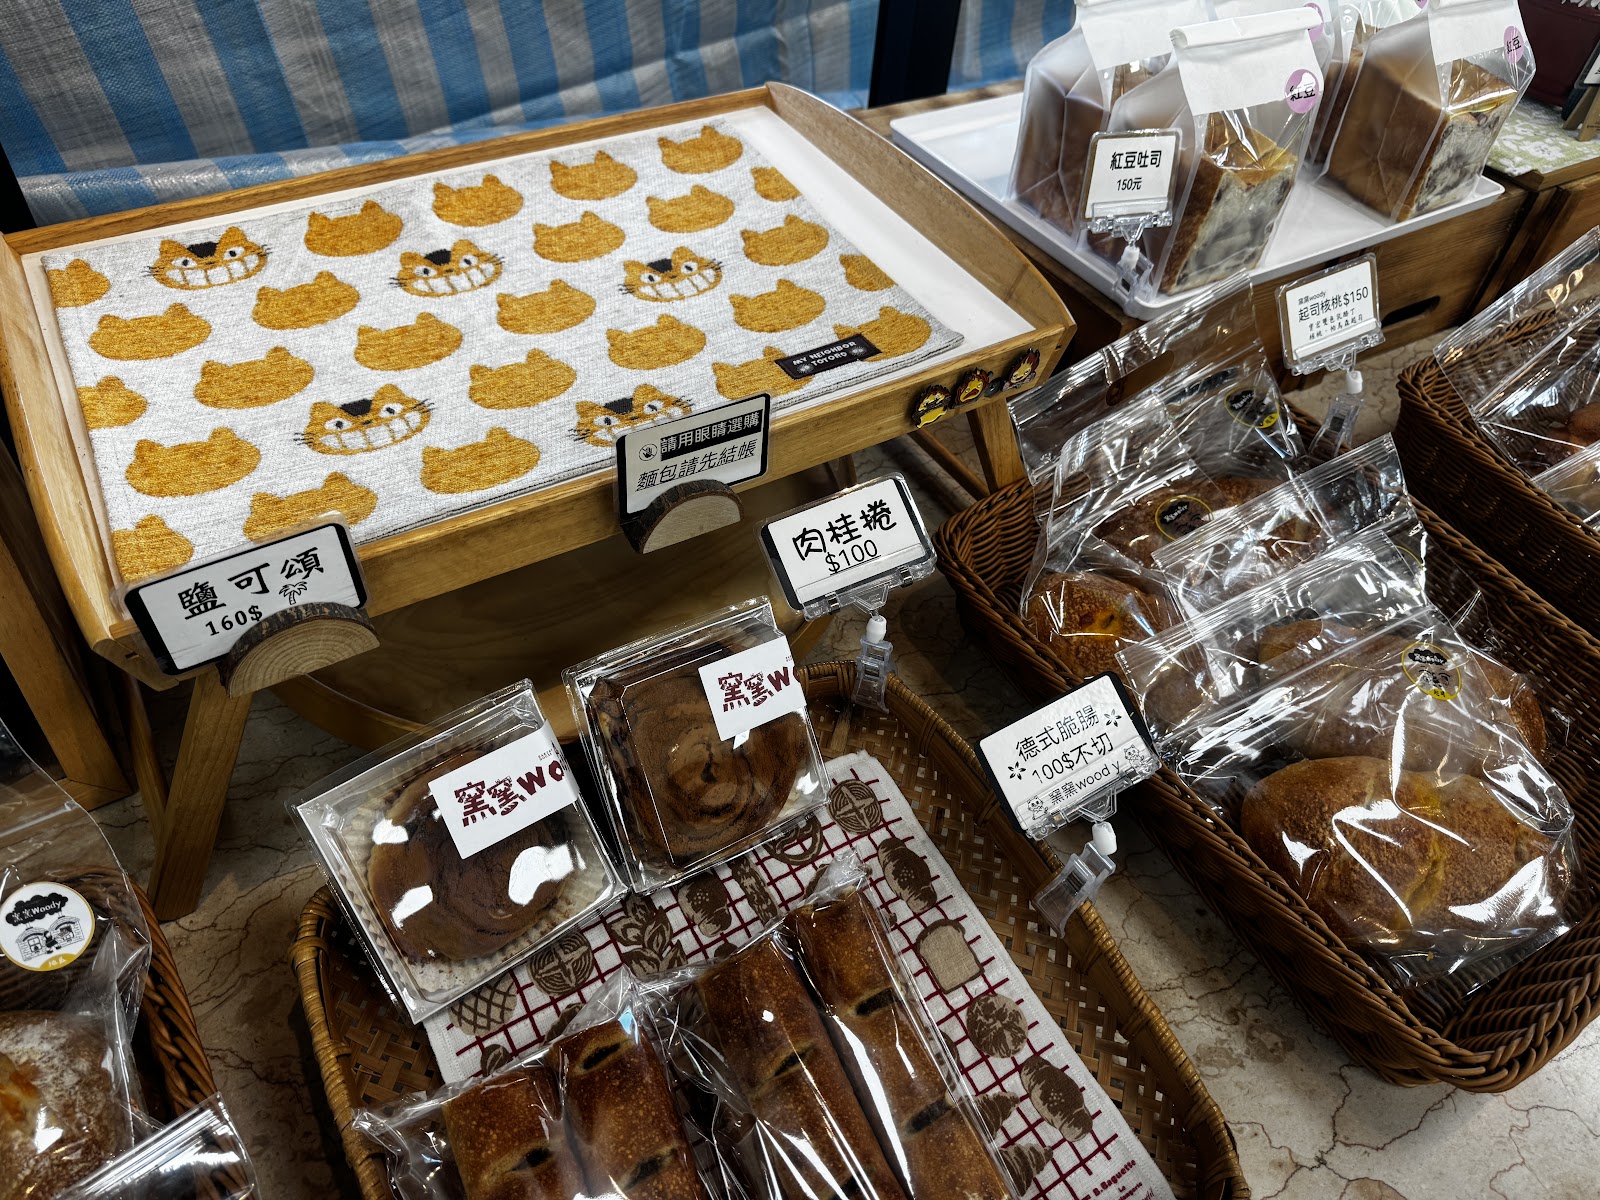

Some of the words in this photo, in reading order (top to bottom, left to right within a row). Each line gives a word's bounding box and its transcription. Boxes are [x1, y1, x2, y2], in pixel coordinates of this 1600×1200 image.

[1507, 36, 1522, 54] 紅豆
[1110, 150, 1162, 171] 紅豆吐司
[1116, 177, 1142, 191] 150元
[1298, 286, 1369, 322] 起司核桃$150
[793, 356, 807, 366] MY
[809, 341, 857, 360] NEIGHBOR
[811, 351, 848, 367] TOTORO
[660, 411, 760, 454] 請用眼睛選購
[635, 439, 758, 492] 麵包請先結帳
[792, 499, 897, 561] 肉桂捲
[825, 539, 879, 574] $100
[177, 547, 325, 620] 鹽可頌
[205, 604, 263, 636] 160$
[1015, 704, 1100, 762] 德式脆腸
[1031, 732, 1114, 784] 100$不切
